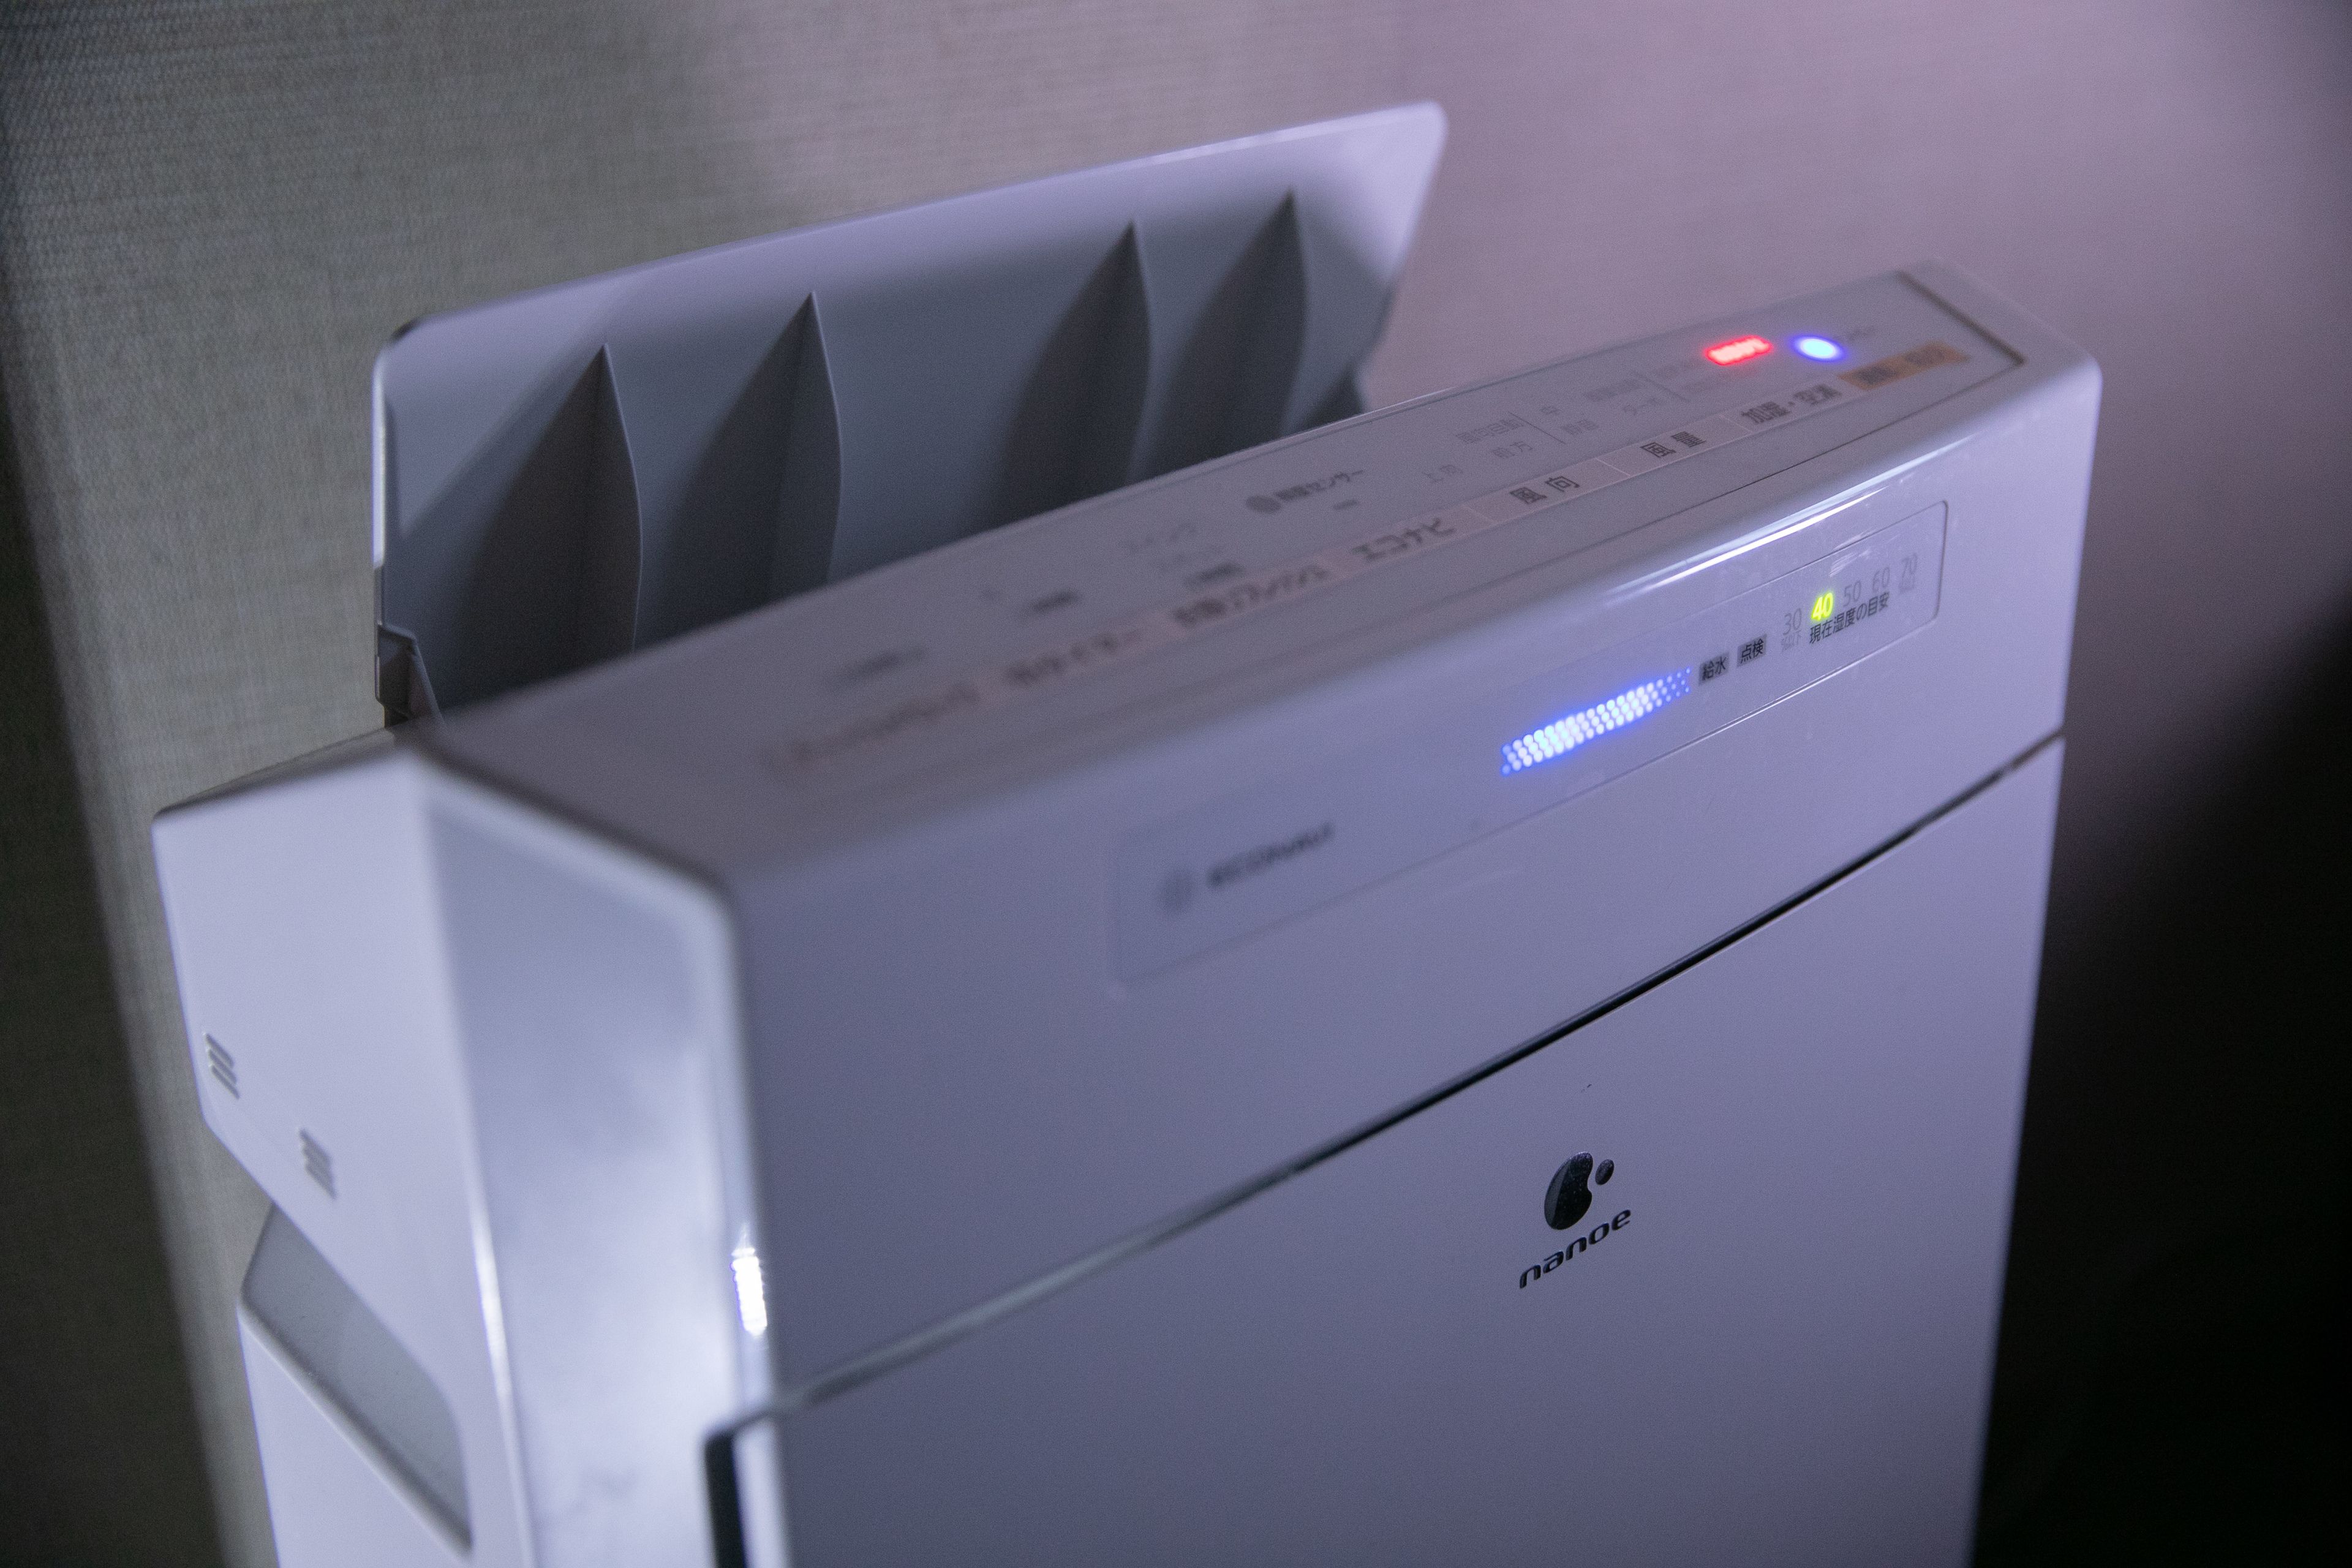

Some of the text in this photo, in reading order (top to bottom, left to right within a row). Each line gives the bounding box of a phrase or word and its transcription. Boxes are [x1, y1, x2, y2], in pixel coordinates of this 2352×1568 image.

[1640, 431, 1706, 458] 風量
[1510, 475, 1580, 505] 風向
[1351, 517, 1455, 560] エコナビ
[1901, 552, 1918, 578] 70
[1842, 579, 1861, 608] 50
[1872, 566, 1890, 593] 60
[1809, 591, 1890, 644] 現在湿度の目安
[1811, 592, 1834, 622] 40
[1782, 608, 1802, 636] 30
[1740, 638, 1764, 663] 点検
[1702, 656, 1727, 682] 給水
[1519, 1209, 1632, 1289] nanoe
